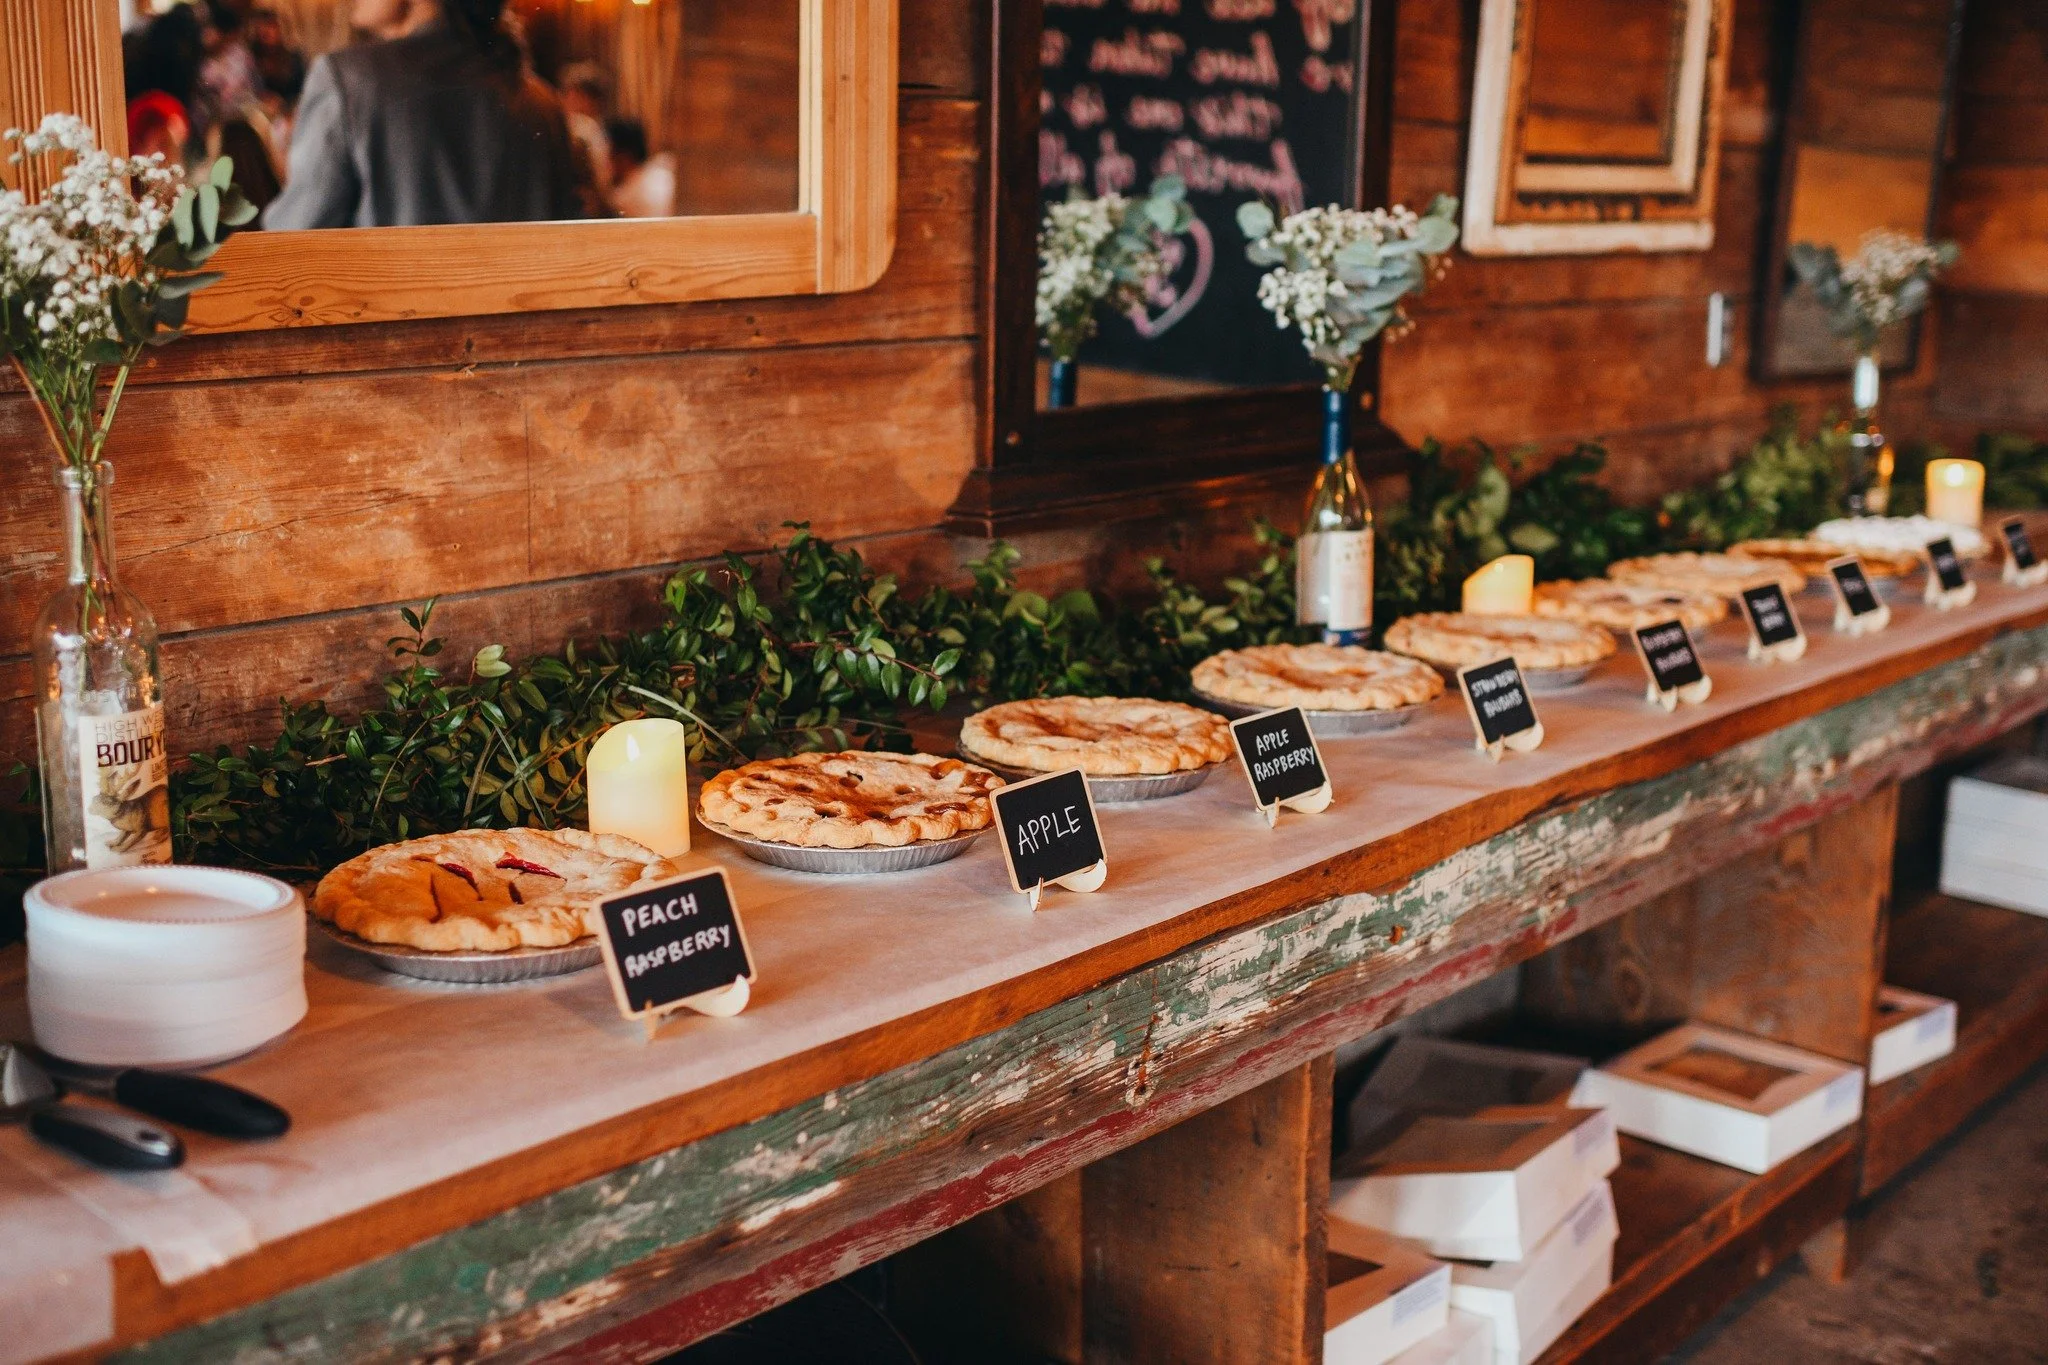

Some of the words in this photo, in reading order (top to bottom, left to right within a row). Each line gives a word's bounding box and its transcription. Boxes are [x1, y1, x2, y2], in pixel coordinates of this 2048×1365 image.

[1253, 746, 1315, 782] RASPBERRY
[1256, 728, 1289, 756] APPLE
[1018, 805, 1081, 855] APPLE
[621, 892, 698, 937] PEACH
[624, 924, 730, 979] RASPBERRY
